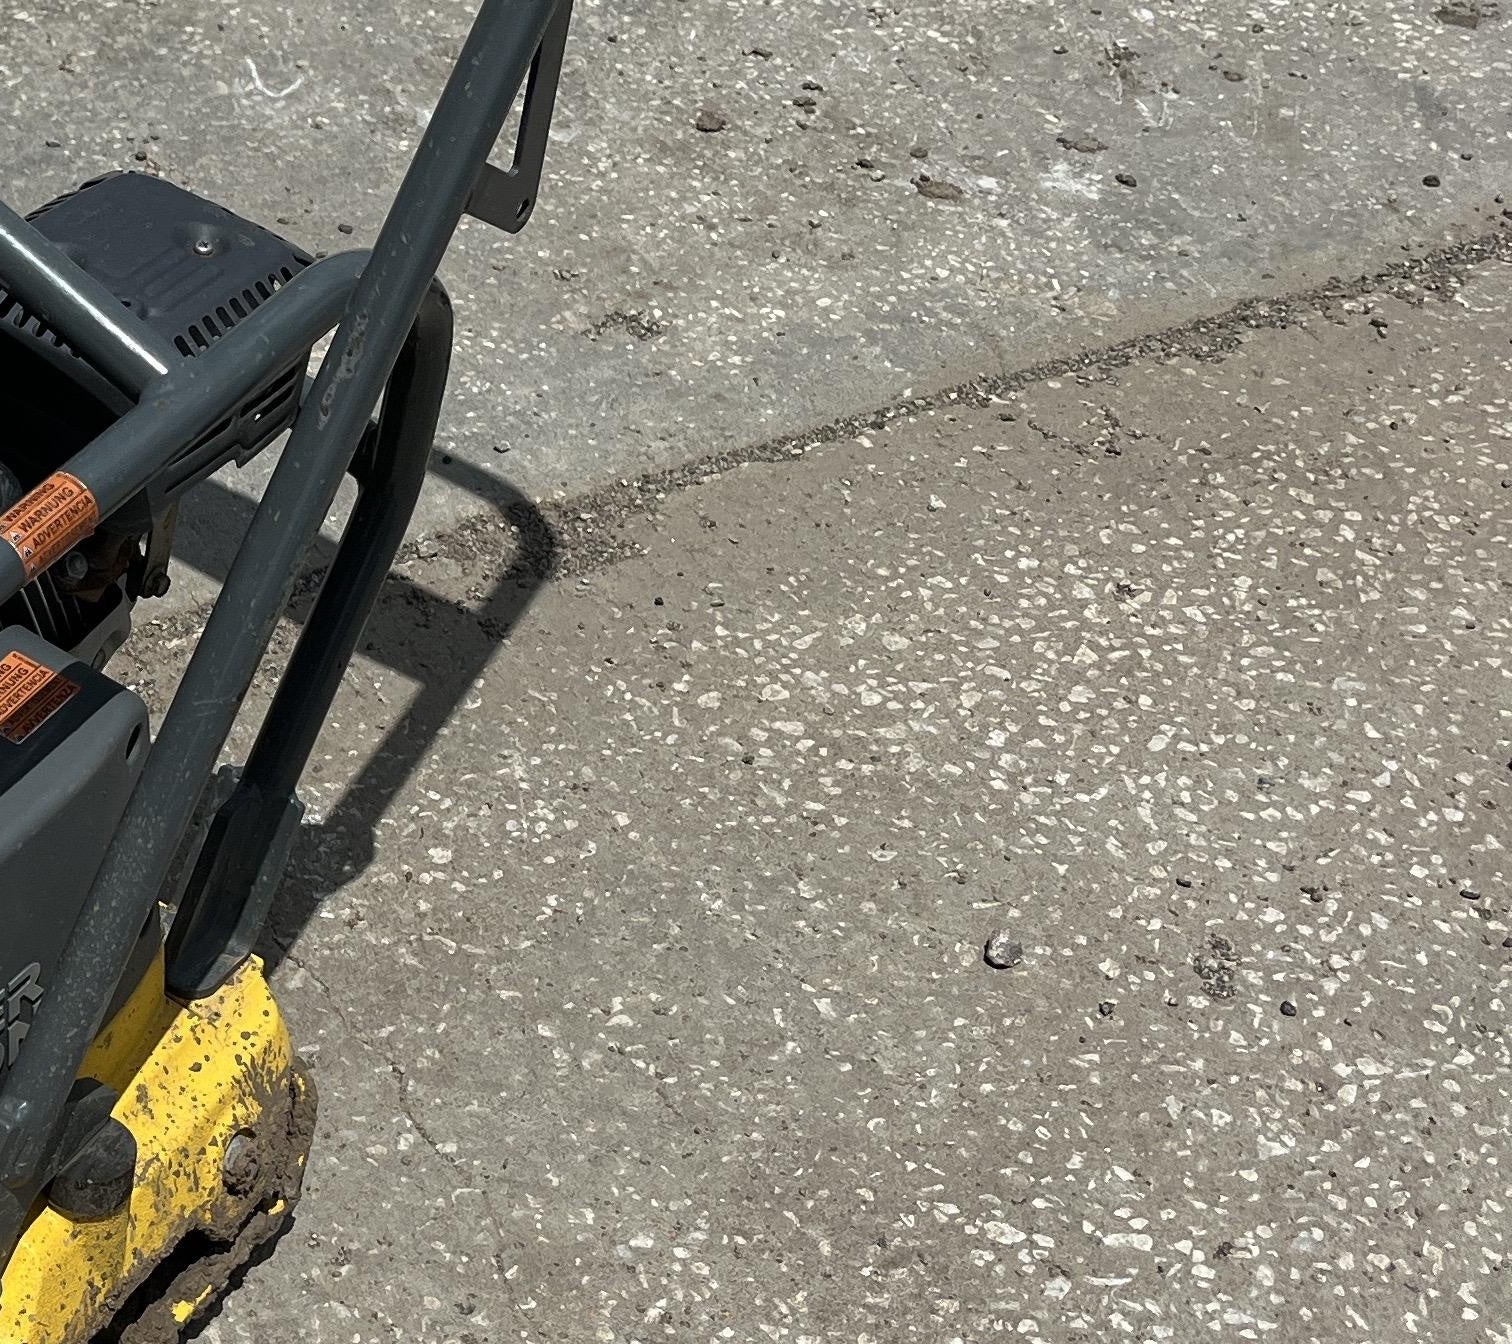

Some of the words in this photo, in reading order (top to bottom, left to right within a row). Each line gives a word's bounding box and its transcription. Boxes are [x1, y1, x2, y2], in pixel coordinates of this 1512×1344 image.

[3, 483, 55, 522] WARNING
[18, 486, 74, 533] WARNUNG
[32, 494, 92, 548] ADVERTENCIA
